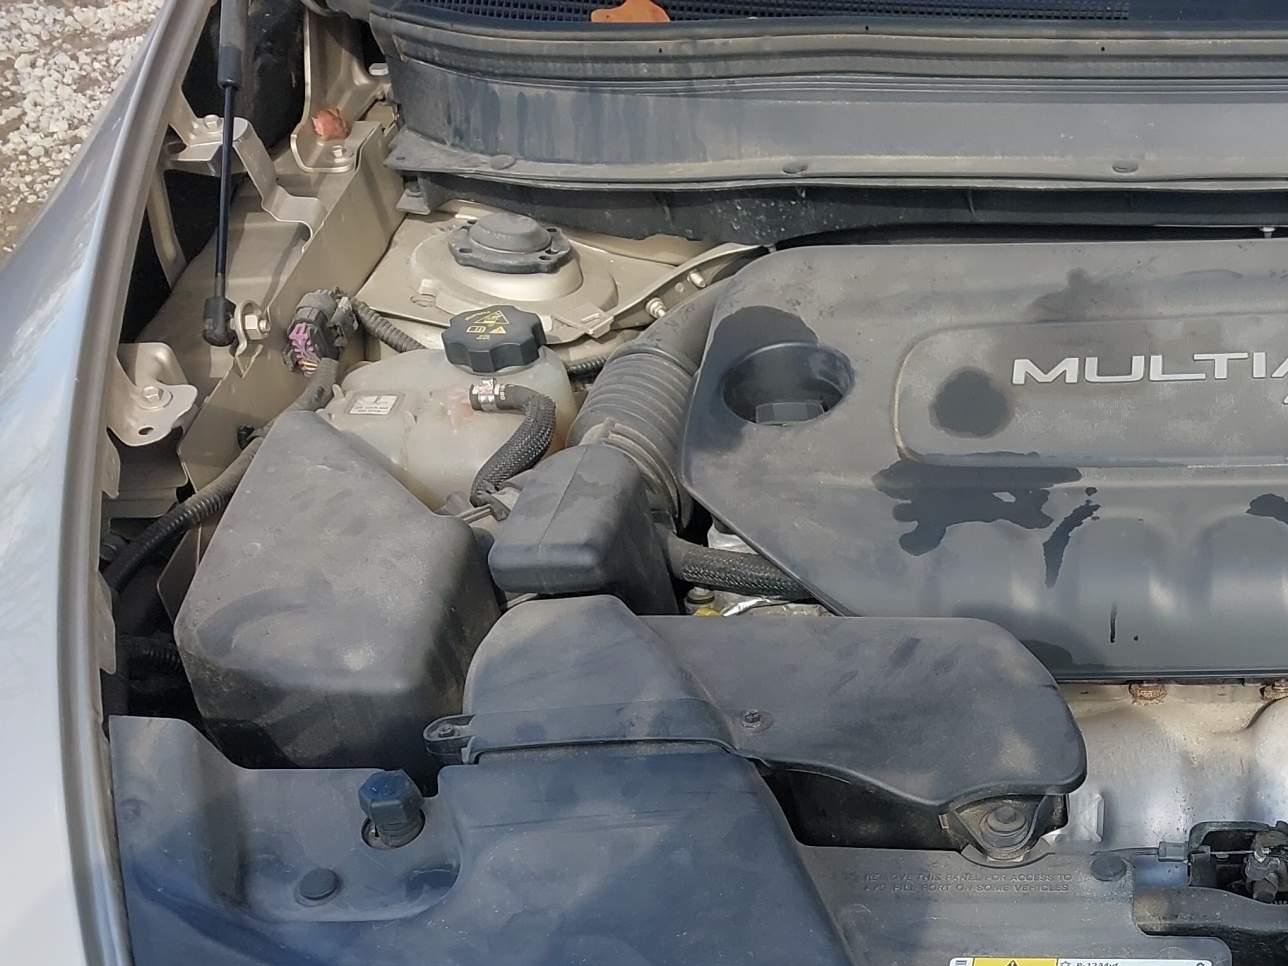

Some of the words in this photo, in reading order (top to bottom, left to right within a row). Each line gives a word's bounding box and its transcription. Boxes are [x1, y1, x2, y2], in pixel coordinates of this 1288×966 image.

[1011, 873, 1056, 881] ACCESS
[1058, 873, 1073, 881] TO
[1014, 884, 1069, 892] VEHICLES
